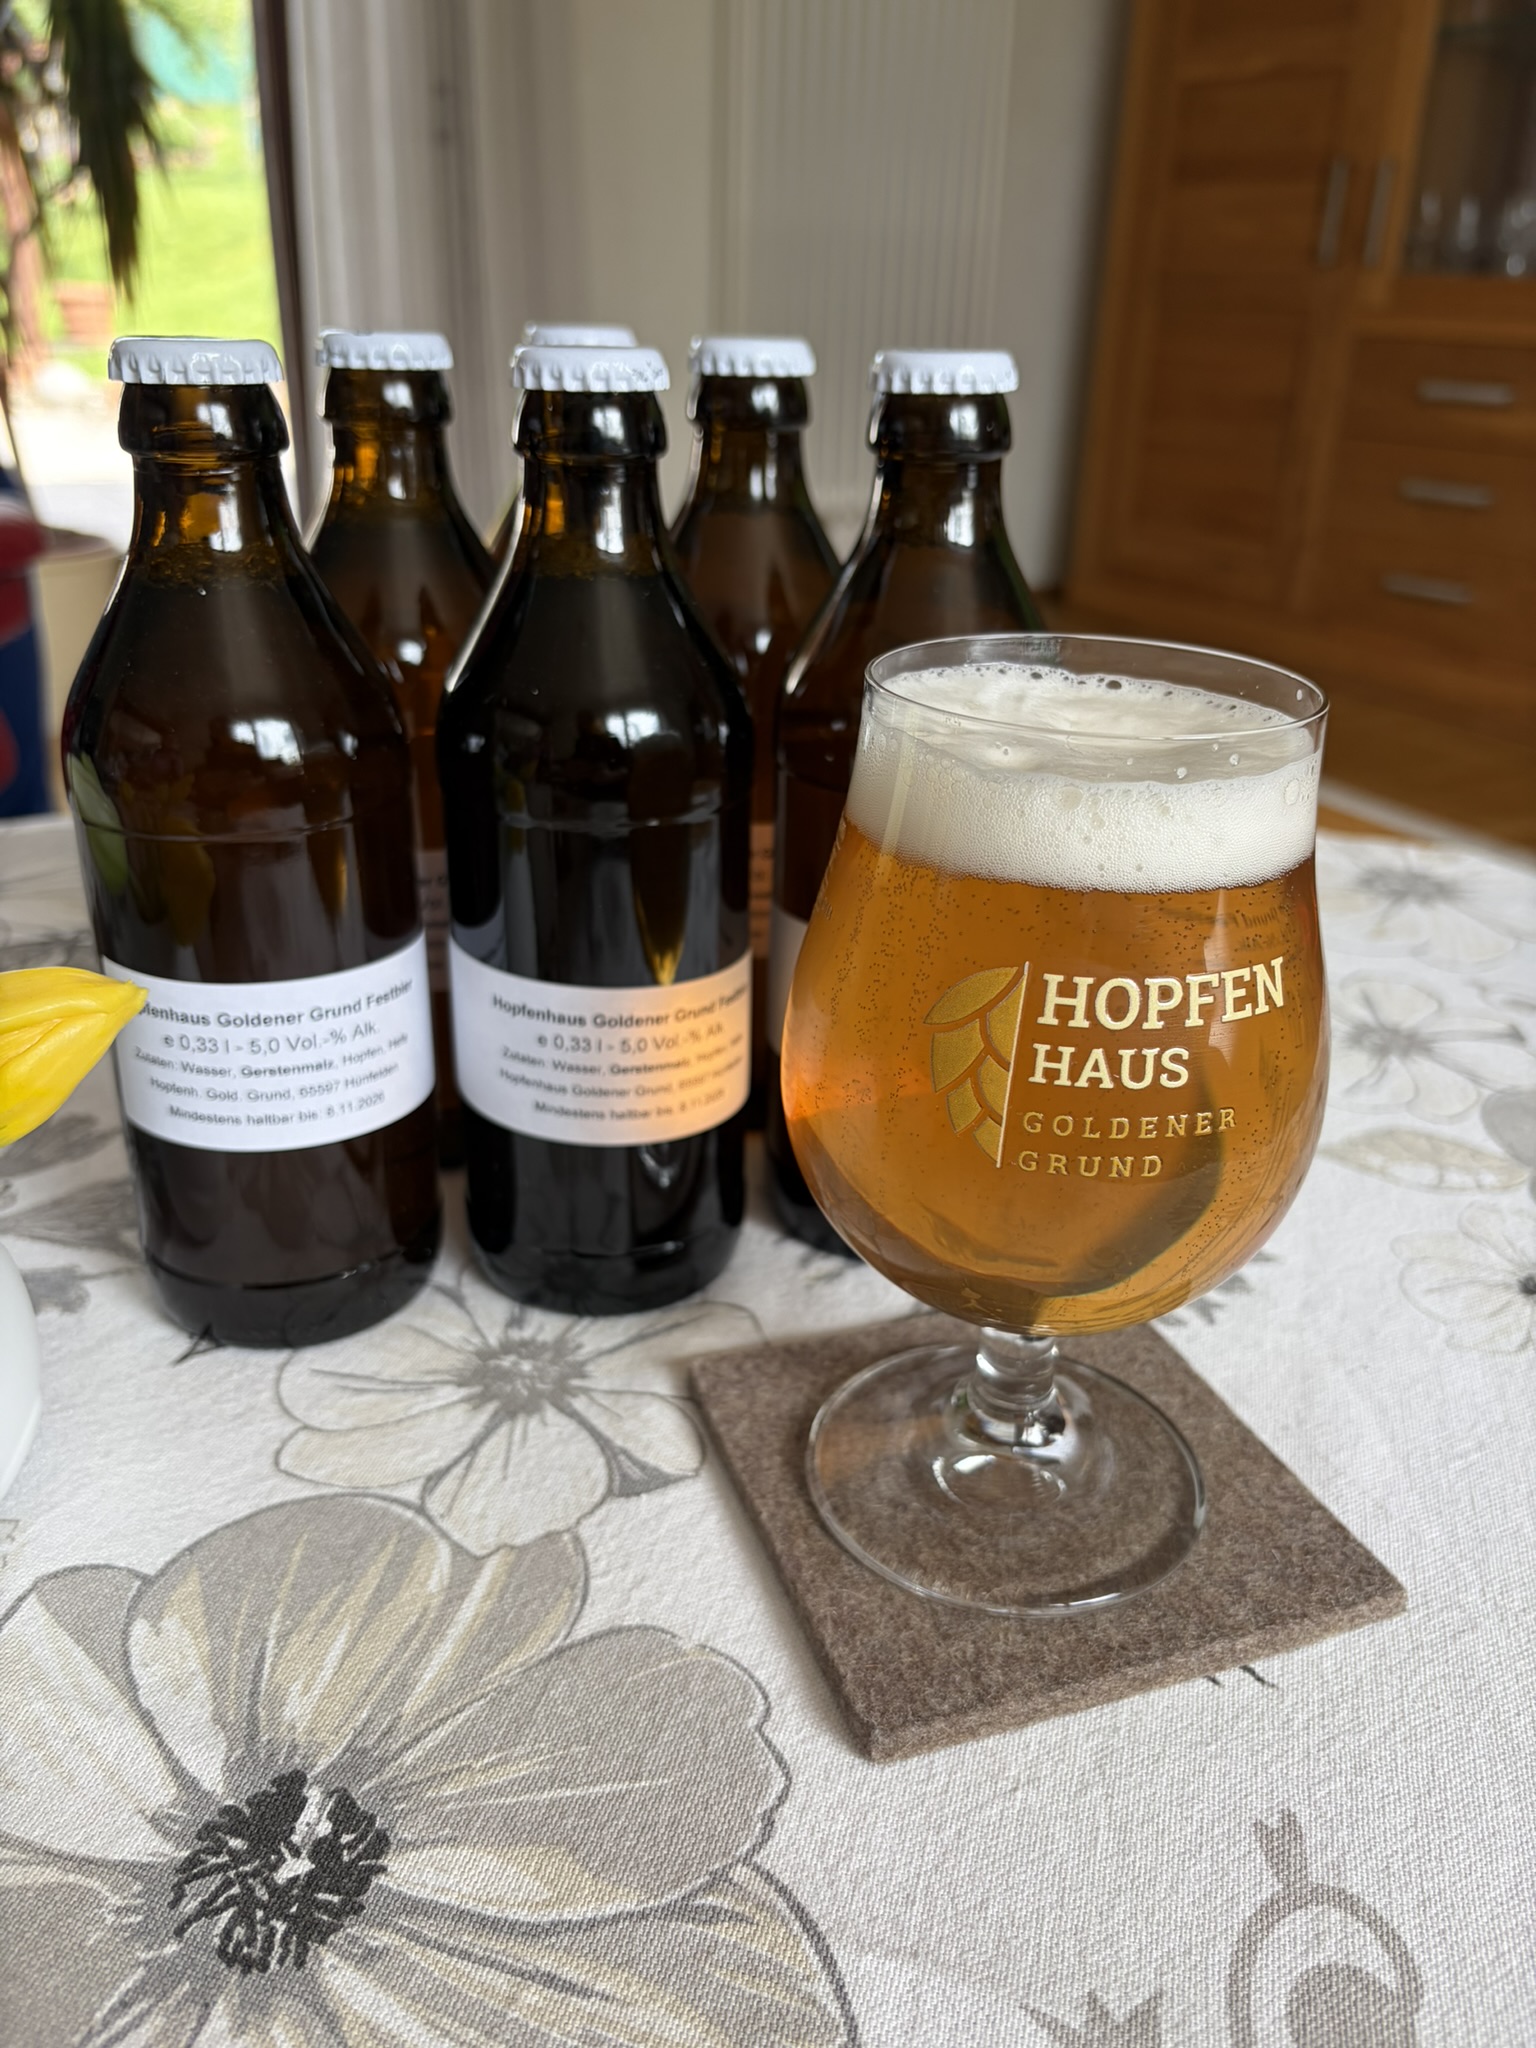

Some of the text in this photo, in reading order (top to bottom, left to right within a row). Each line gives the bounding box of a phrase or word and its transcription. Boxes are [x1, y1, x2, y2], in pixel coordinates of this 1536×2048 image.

[1037, 956, 1285, 1031] HOPFEN
[138, 1001, 211, 1027] fenhaus
[216, 1012, 305, 1029] Goldener
[309, 998, 362, 1022] Grund
[492, 993, 587, 1028] Hopfenhaus
[592, 1013, 670, 1029] Goldener
[178, 1033, 219, 1054] 0,33
[249, 1036, 281, 1057] 5,0
[552, 1033, 592, 1054] 0,33
[620, 1037, 648, 1055] 5,0
[180, 1061, 237, 1079] Wasser,
[240, 1058, 338, 1079] Gerstenmalz,
[550, 1059, 606, 1077] Wasser,
[1028, 1043, 1190, 1091] HAUS
[246, 1087, 296, 1103] Grund,
[168, 1103, 243, 1126] Mindestens
[247, 1113, 294, 1126] haltbar
[533, 1099, 606, 1121] Mindestens
[1022, 1108, 1237, 1140] GOLDENER
[1017, 1150, 1164, 1178] GRUND
